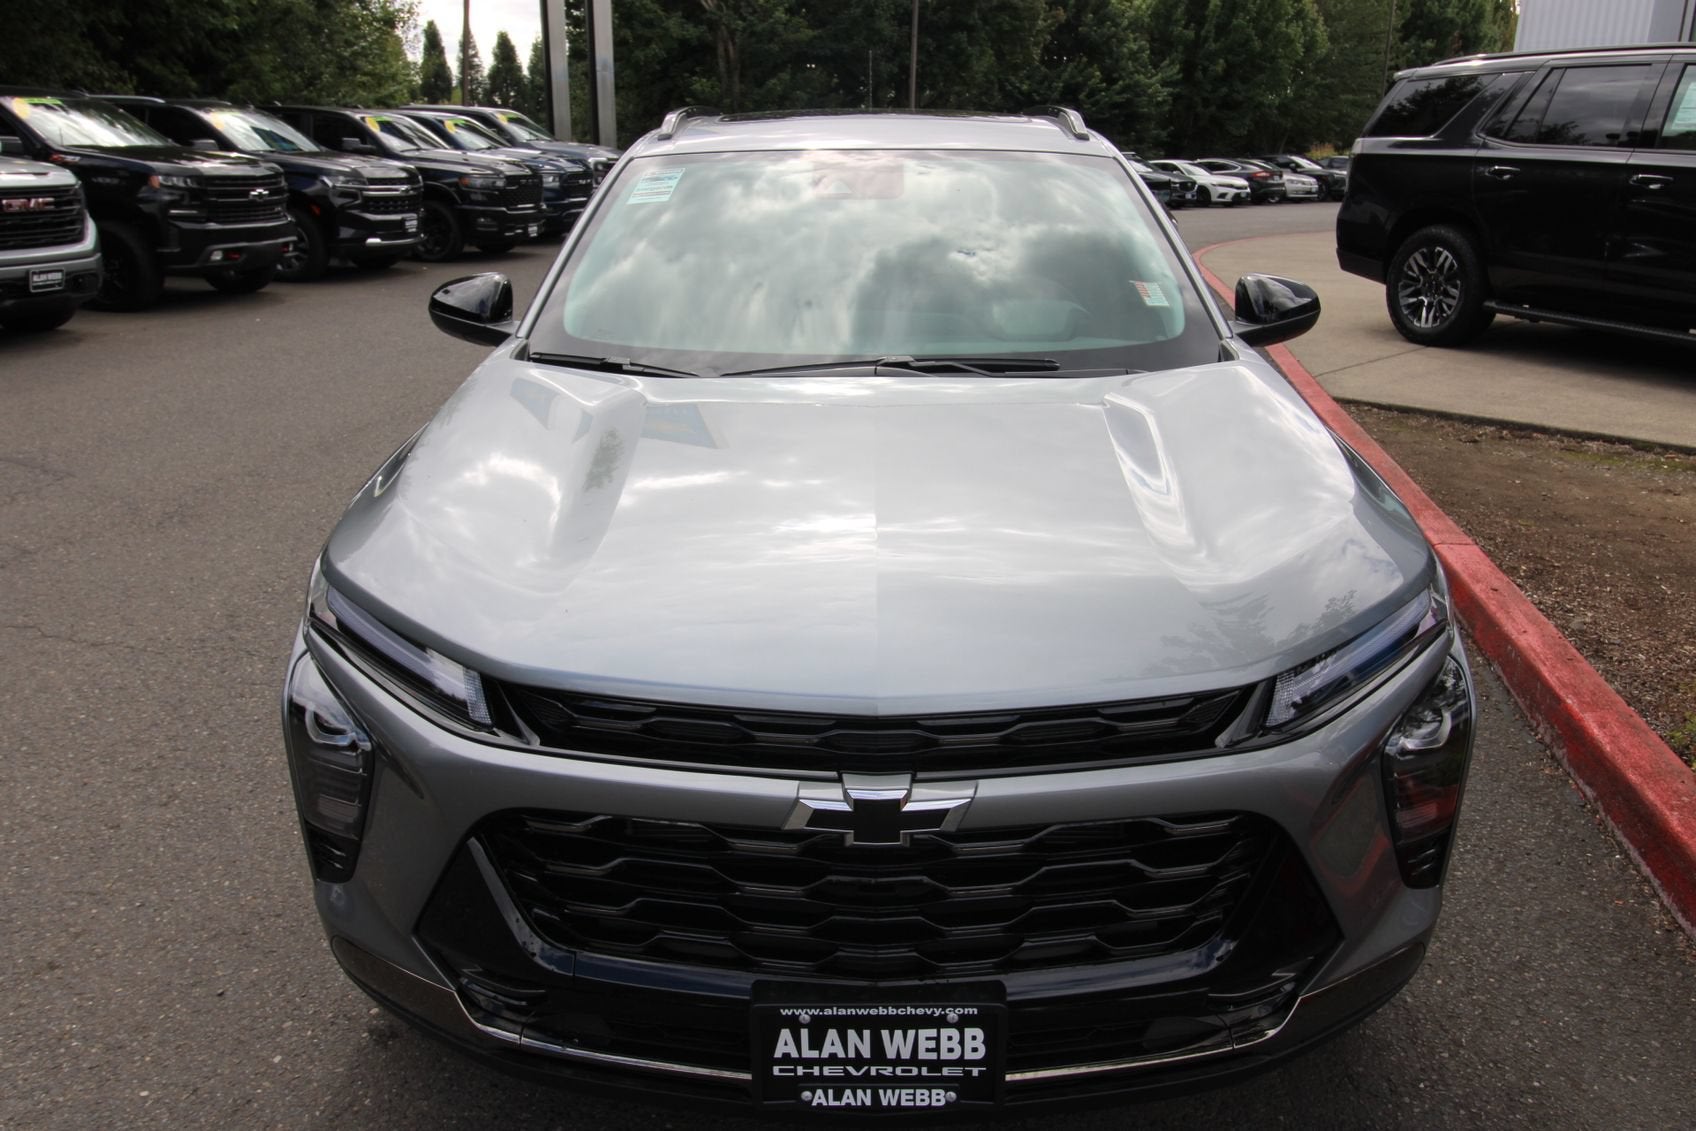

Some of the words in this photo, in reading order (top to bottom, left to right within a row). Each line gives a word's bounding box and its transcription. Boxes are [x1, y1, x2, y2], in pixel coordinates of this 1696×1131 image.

[2, 198, 55, 211] GMC
[780, 1006, 978, 1017] www.alanwebbchevy.com
[773, 1028, 871, 1059] ALAN
[881, 1027, 986, 1060] WEBB
[773, 1066, 987, 1077] CHEVROLET
[812, 1089, 872, 1106] ALAN
[879, 1089, 946, 1107] WEBB
